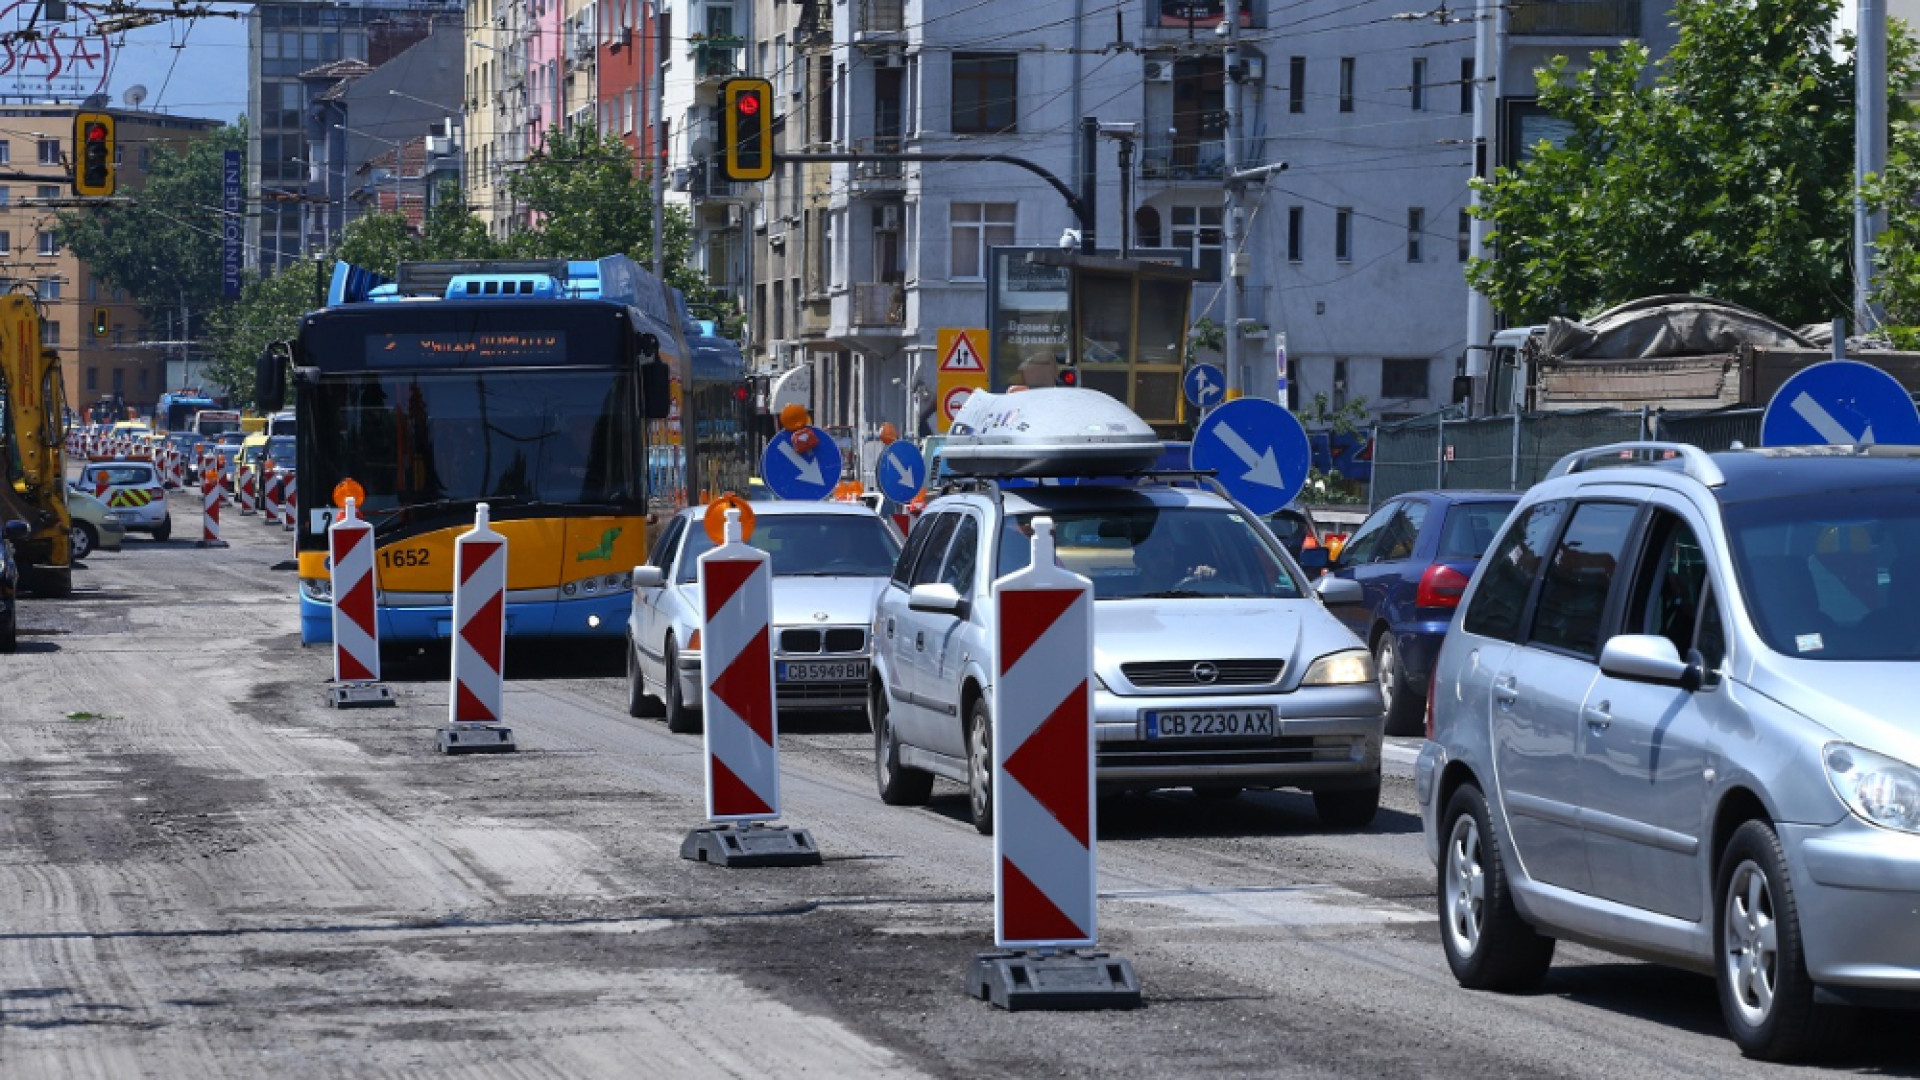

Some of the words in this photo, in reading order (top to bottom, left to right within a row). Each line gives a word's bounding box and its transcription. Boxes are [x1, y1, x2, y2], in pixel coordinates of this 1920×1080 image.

[381, 548, 430, 568] 1652
[1160, 714, 1186, 734] CB
[1190, 713, 1239, 734] 2230
[1243, 712, 1269, 733] AX
